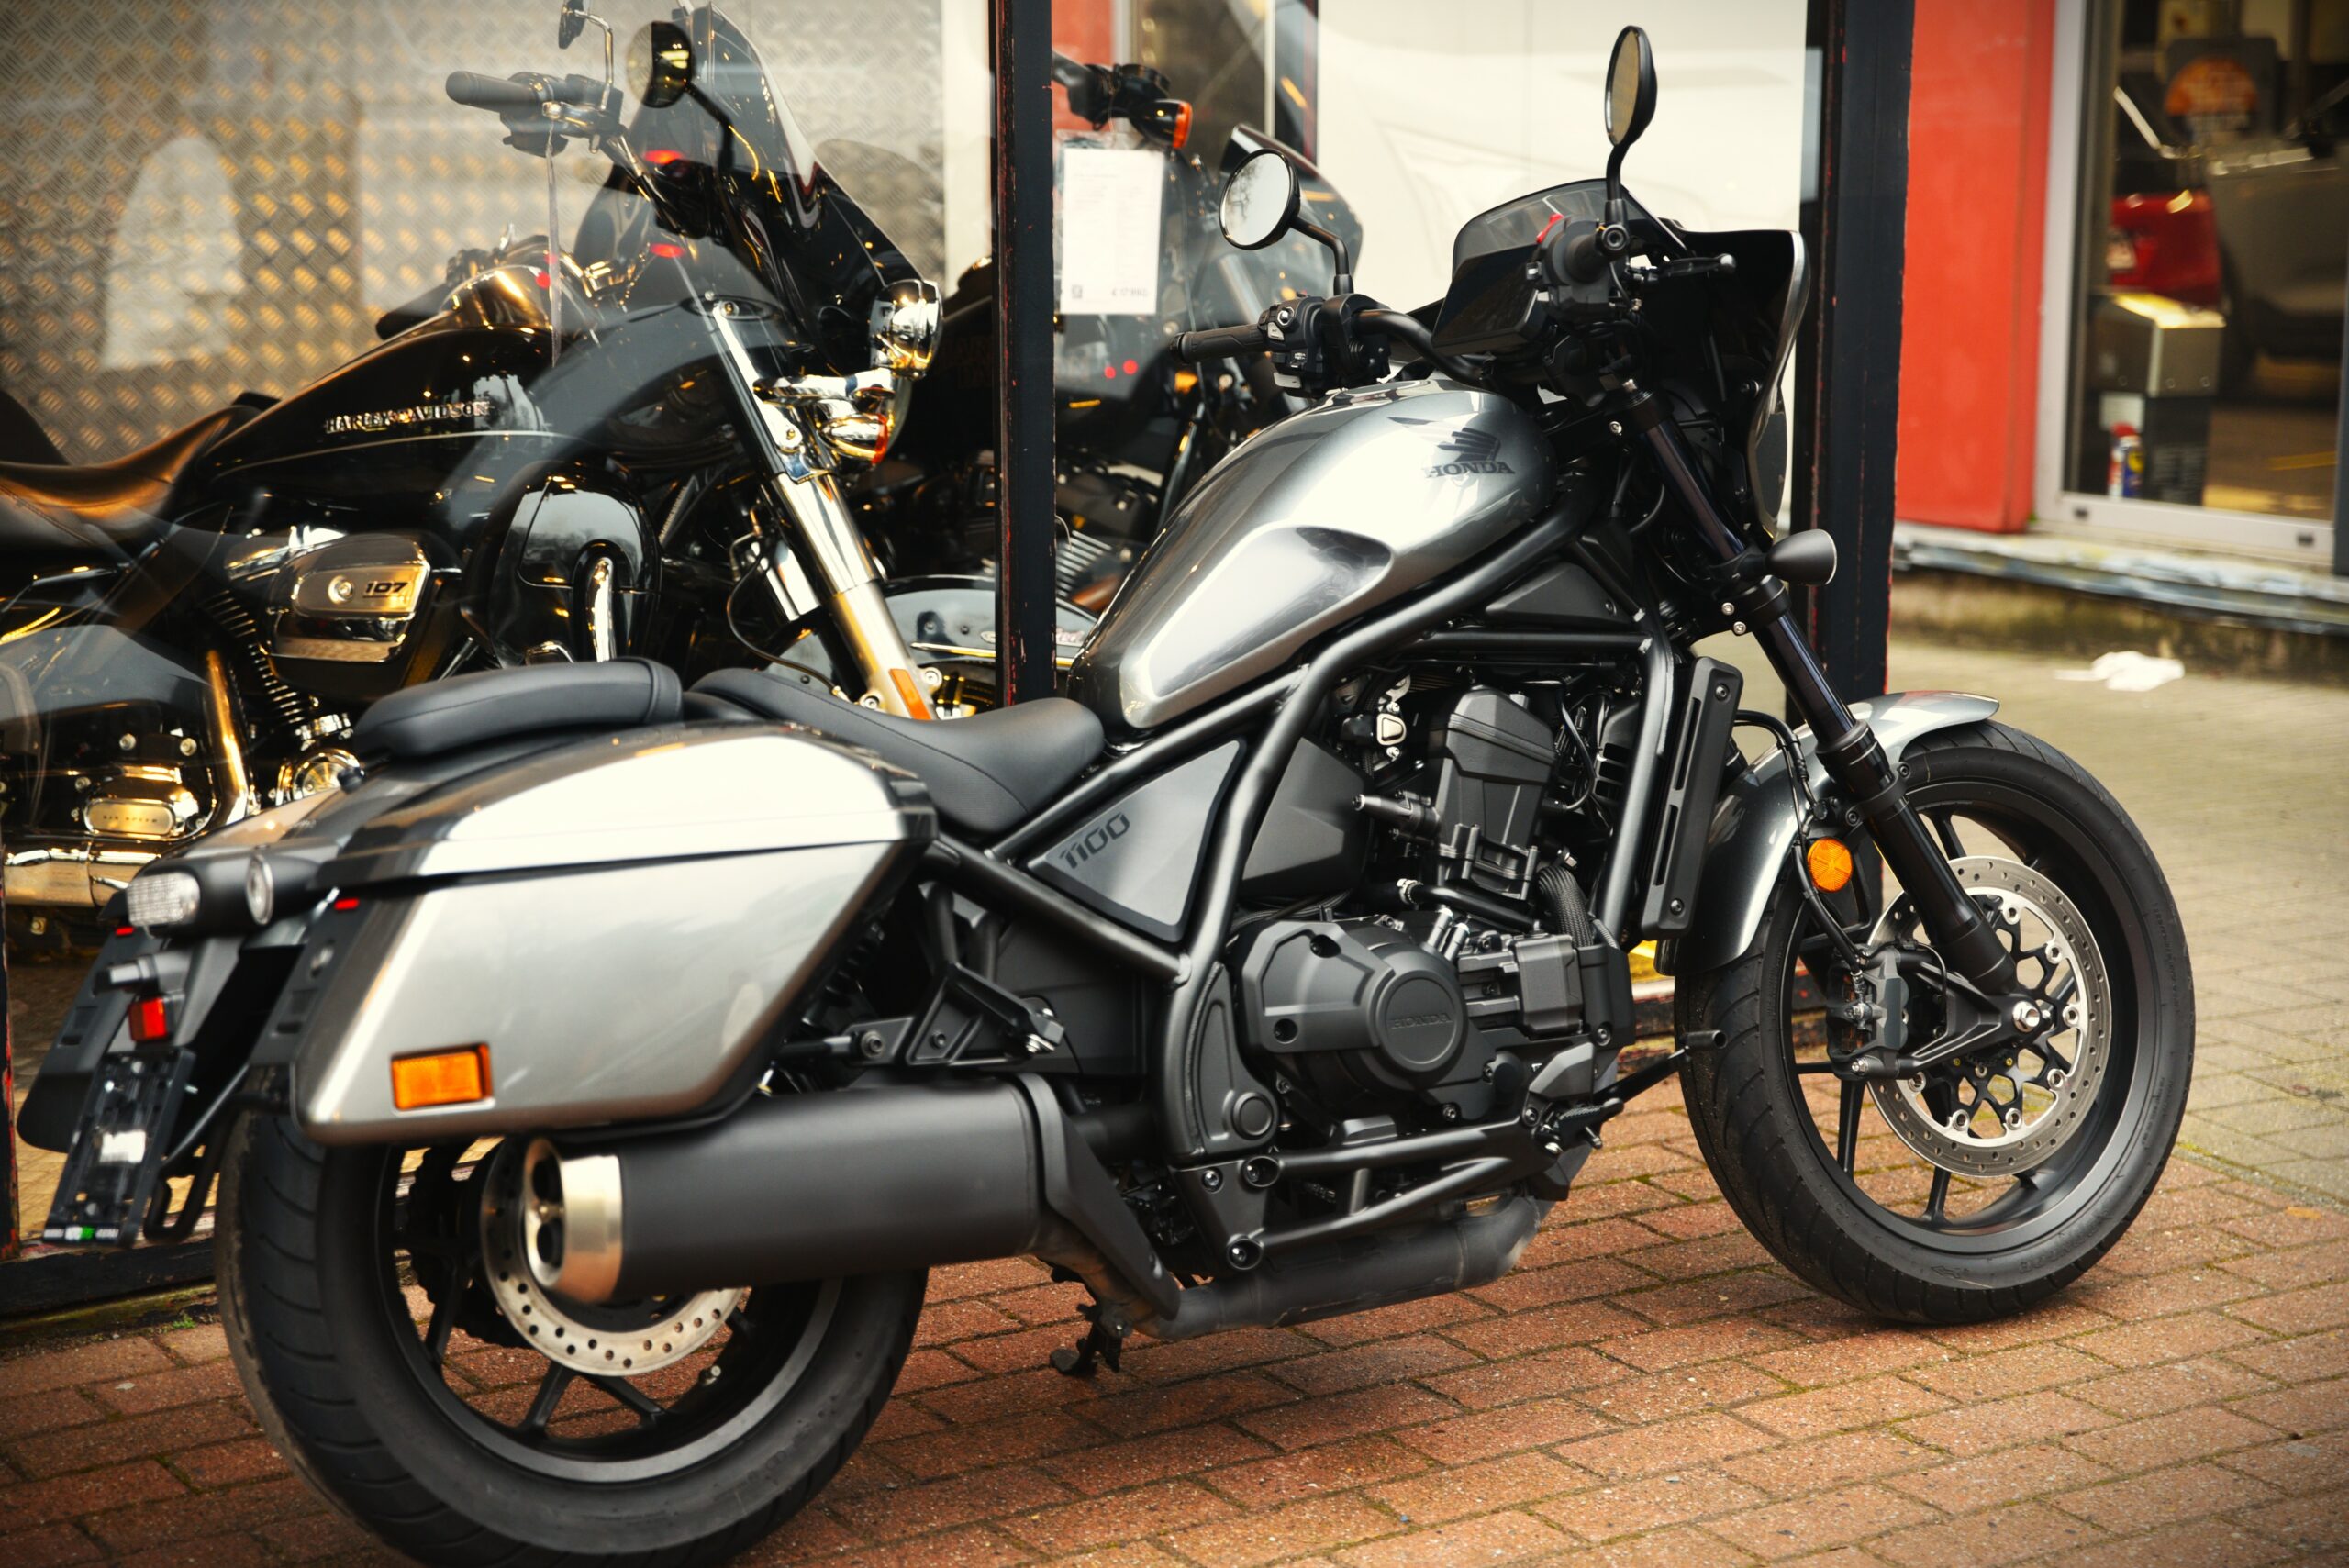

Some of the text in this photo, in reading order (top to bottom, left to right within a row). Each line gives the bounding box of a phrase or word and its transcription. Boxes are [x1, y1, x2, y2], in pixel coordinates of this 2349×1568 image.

[1421, 462, 1516, 478] HONDA
[365, 582, 408, 594] 107
[1059, 812, 1130, 869] 1100
[1391, 1012, 1453, 1030] HONDA
